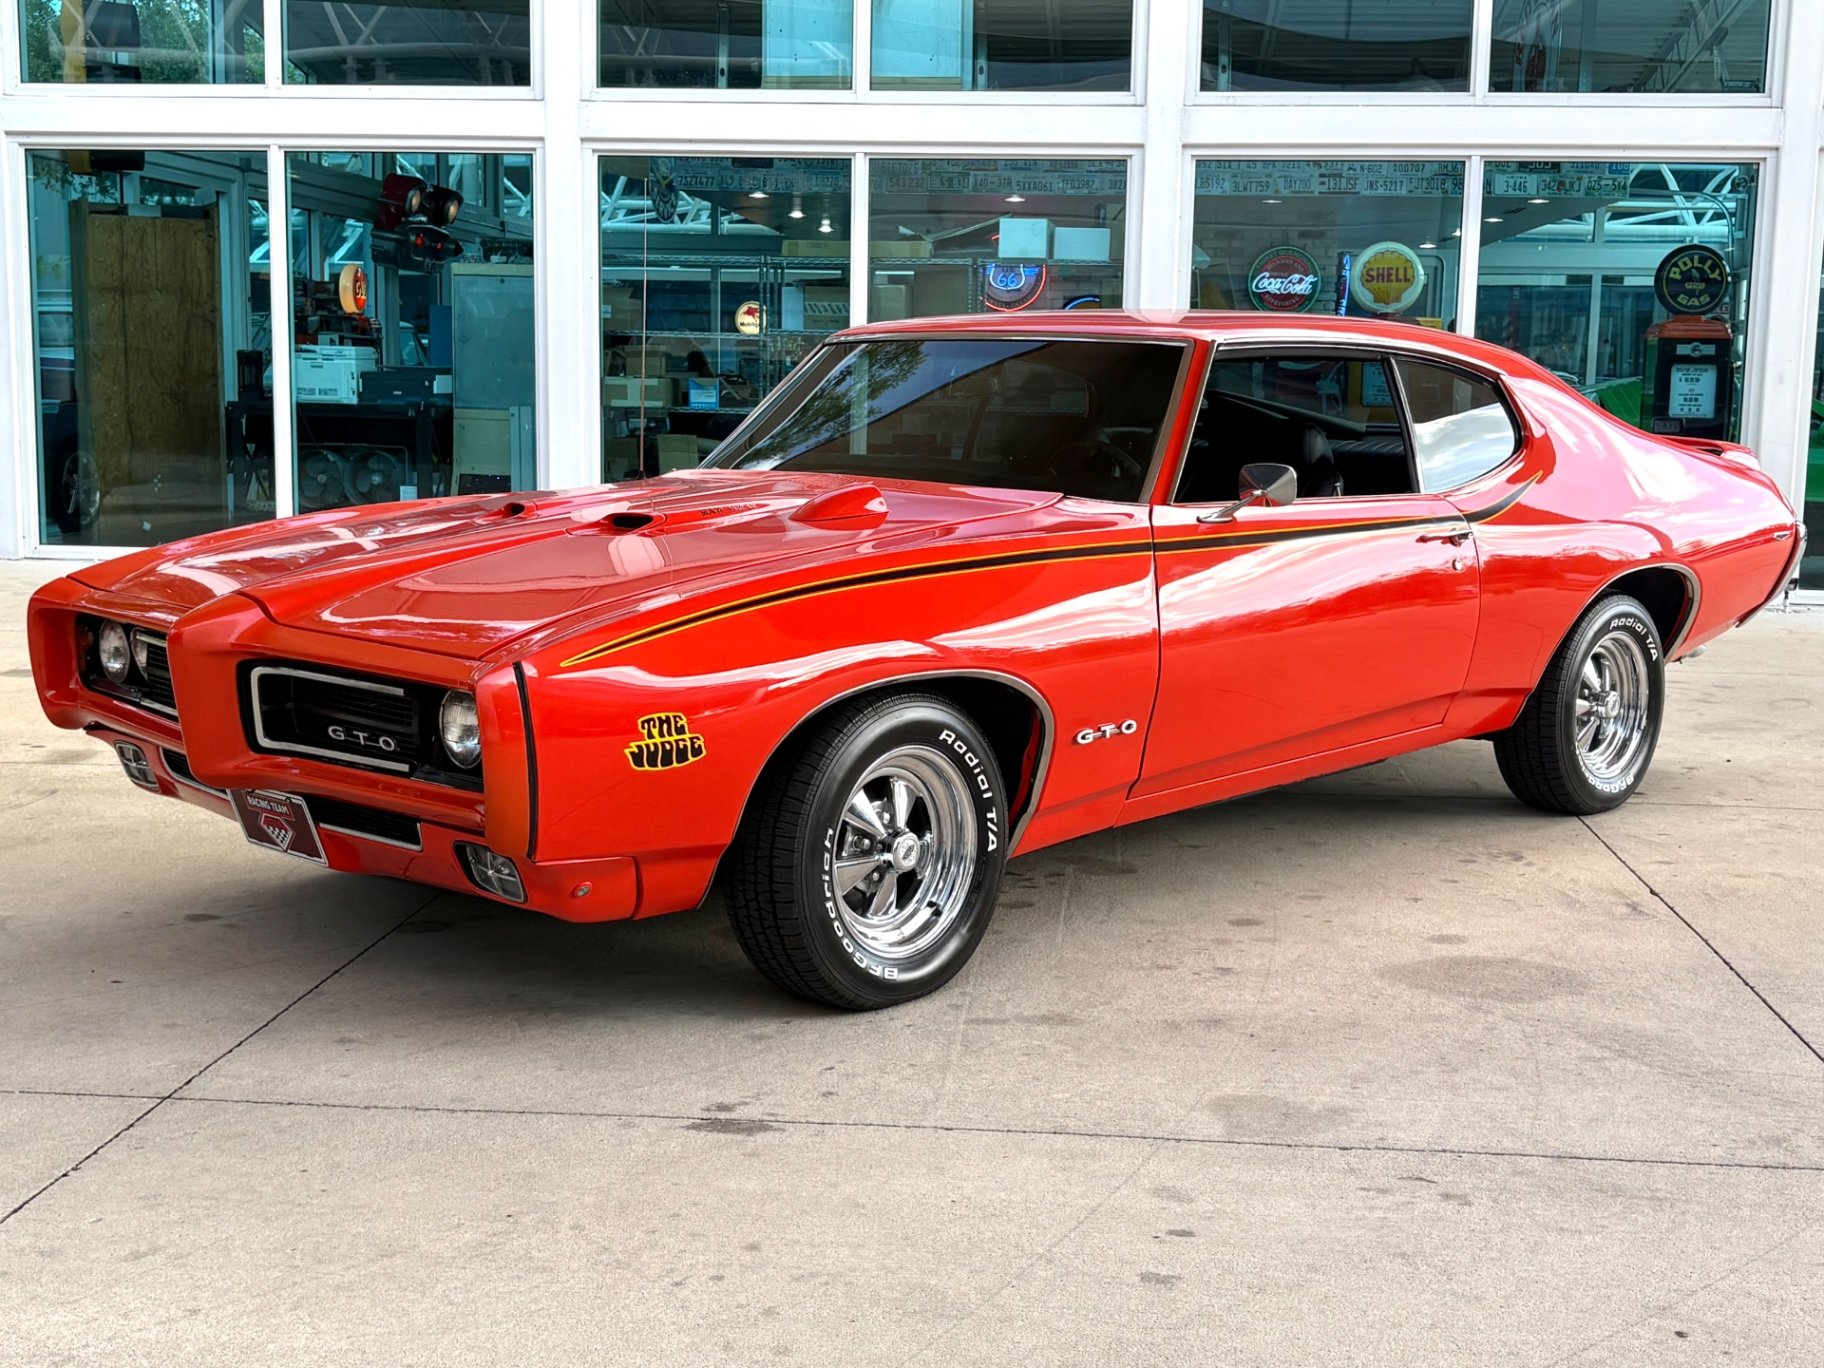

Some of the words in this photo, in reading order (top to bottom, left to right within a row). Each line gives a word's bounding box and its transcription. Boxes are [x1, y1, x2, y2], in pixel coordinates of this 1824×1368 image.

[1231, 180, 1271, 193] 3LWT759
[997, 272, 1018, 287] 66
[1364, 266, 1411, 284] SHELL
[1668, 254, 1722, 281] POLLY
[1252, 271, 1318, 295] Coca-Cola
[1676, 293, 1711, 307] GAS
[1609, 616, 1647, 638] Radial
[1645, 634, 1659, 663] T/A
[639, 713, 687, 740] THE
[627, 735, 705, 769] JUDGE
[938, 728, 994, 799] Radial
[985, 806, 999, 853] T/A
[821, 827, 900, 981] BFGoodrich
